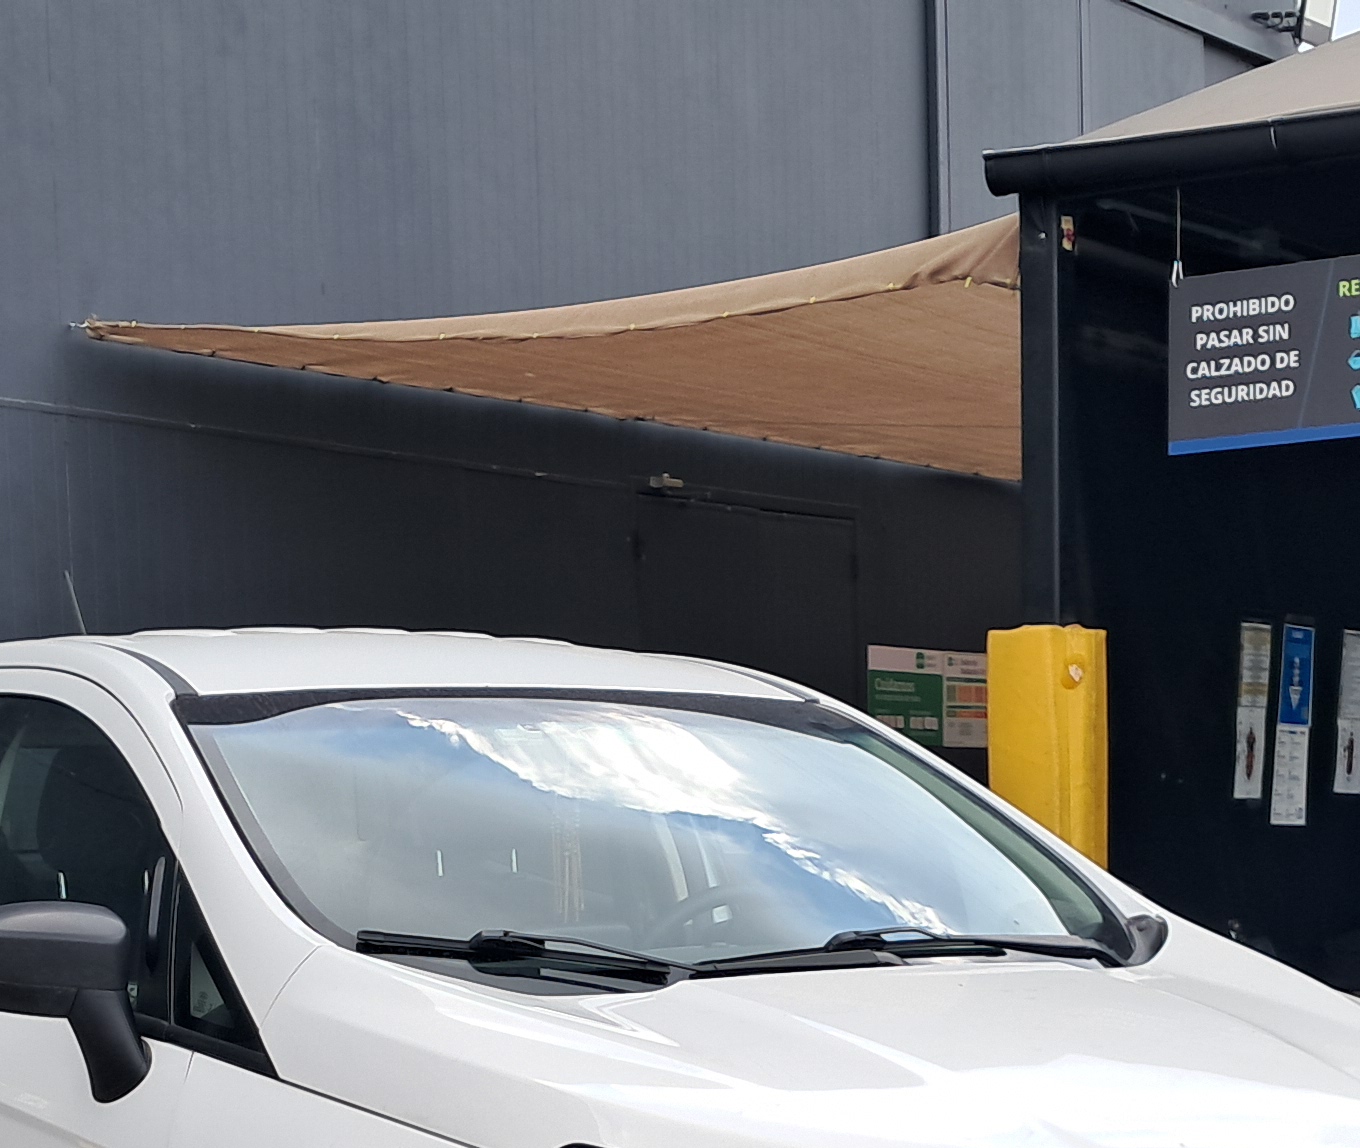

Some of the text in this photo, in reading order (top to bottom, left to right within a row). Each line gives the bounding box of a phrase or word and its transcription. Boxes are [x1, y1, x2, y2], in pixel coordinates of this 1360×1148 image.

[1191, 294, 1295, 323] PROHIBIDO
[1196, 323, 1289, 351] PASAR SIN
[1186, 350, 1300, 379] CALZADO DE
[1189, 380, 1294, 407] SEGURIDAD
